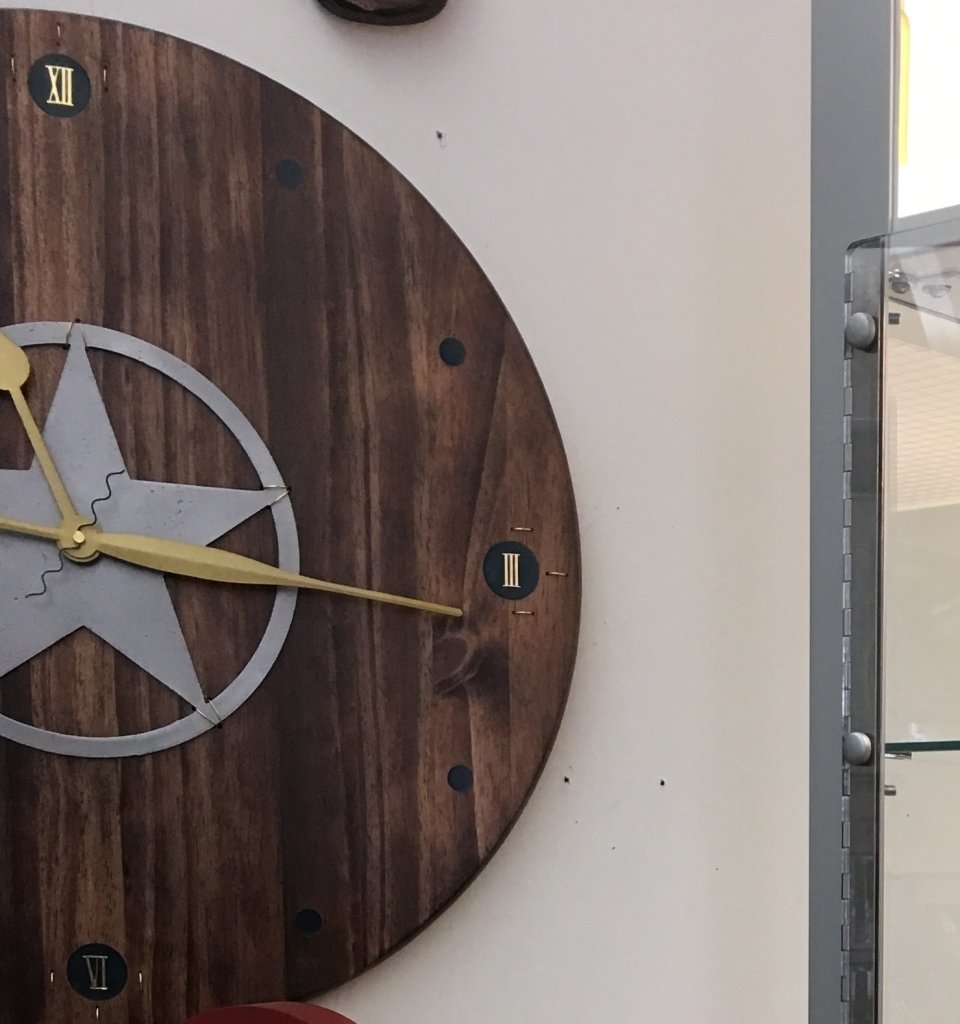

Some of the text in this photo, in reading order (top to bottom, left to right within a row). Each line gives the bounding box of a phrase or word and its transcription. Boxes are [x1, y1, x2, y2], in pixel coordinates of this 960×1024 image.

[45, 65, 74, 106] XII
[502, 552, 521, 588] III
[82, 955, 109, 990] VI
